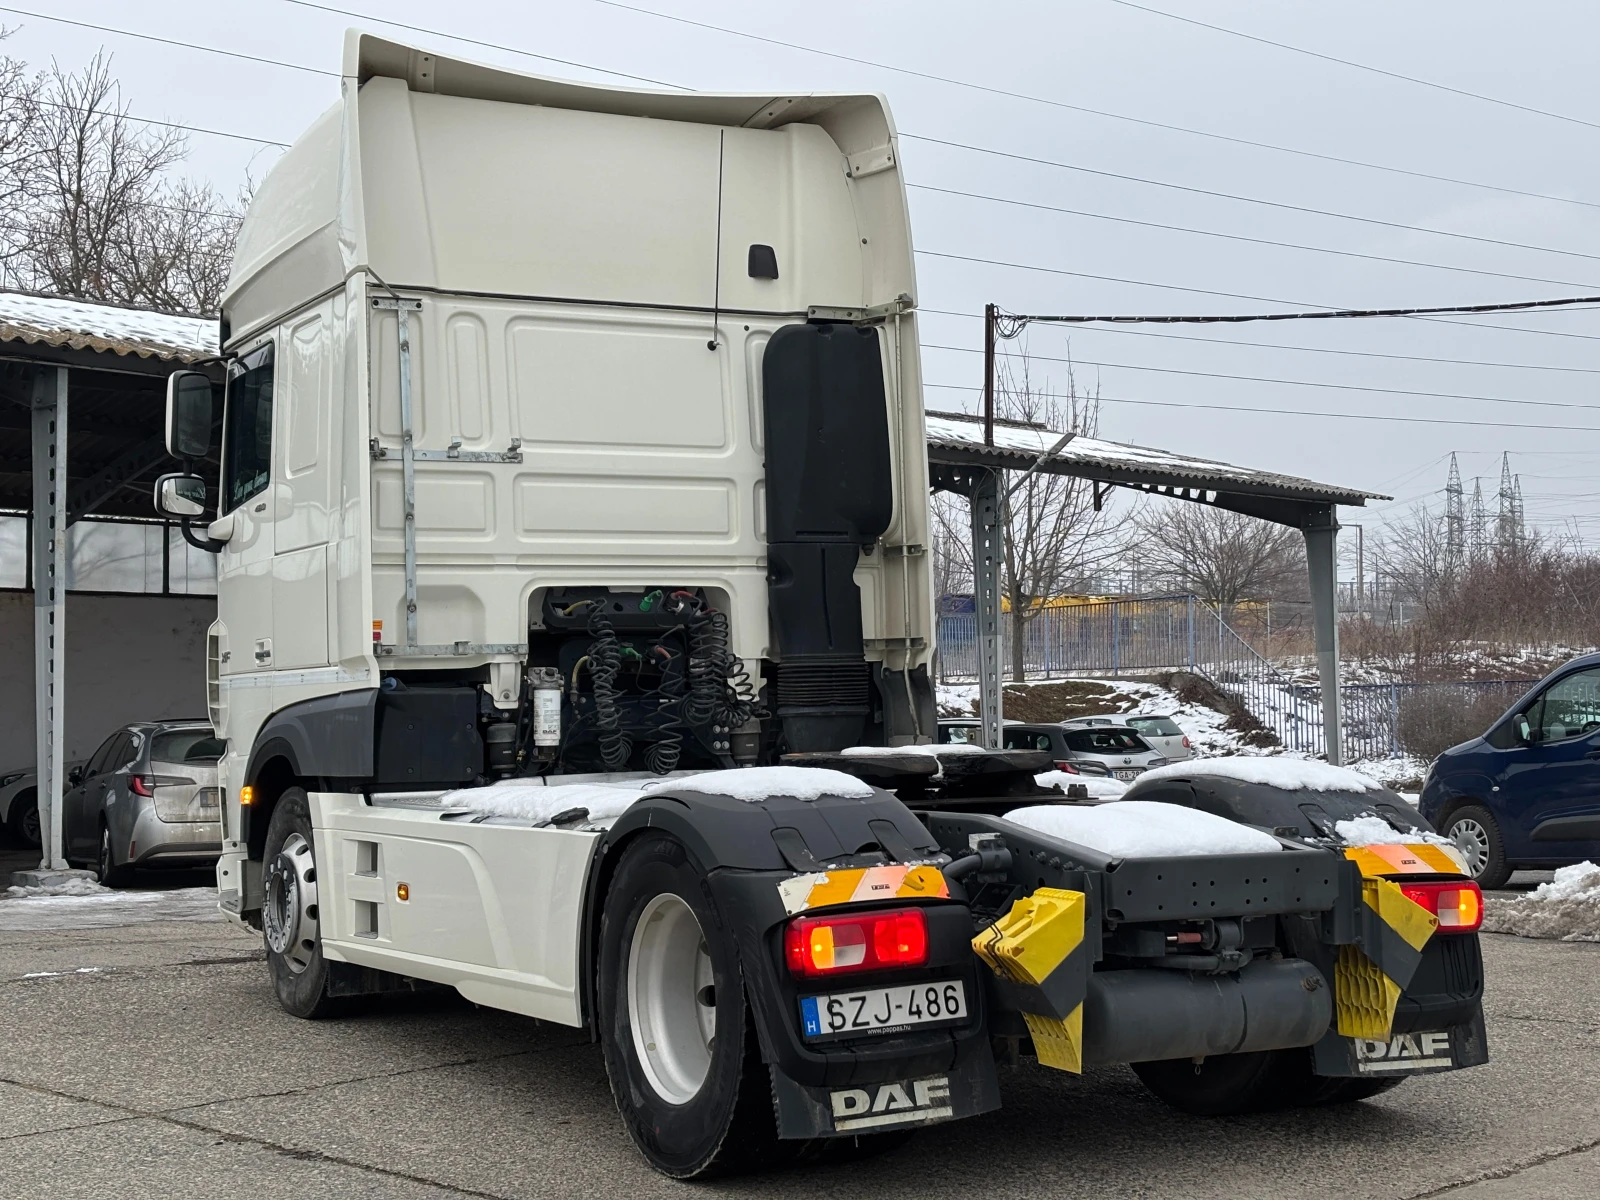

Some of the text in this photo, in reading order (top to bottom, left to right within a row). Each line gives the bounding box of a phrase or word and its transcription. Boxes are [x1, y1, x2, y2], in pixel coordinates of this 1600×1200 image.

[826, 985, 960, 1030] SZJ-486
[807, 1020, 817, 1033] H
[867, 1025, 911, 1035] www.pappas.hu
[1355, 1032, 1450, 1059] DAF
[830, 1077, 950, 1117] DAF
